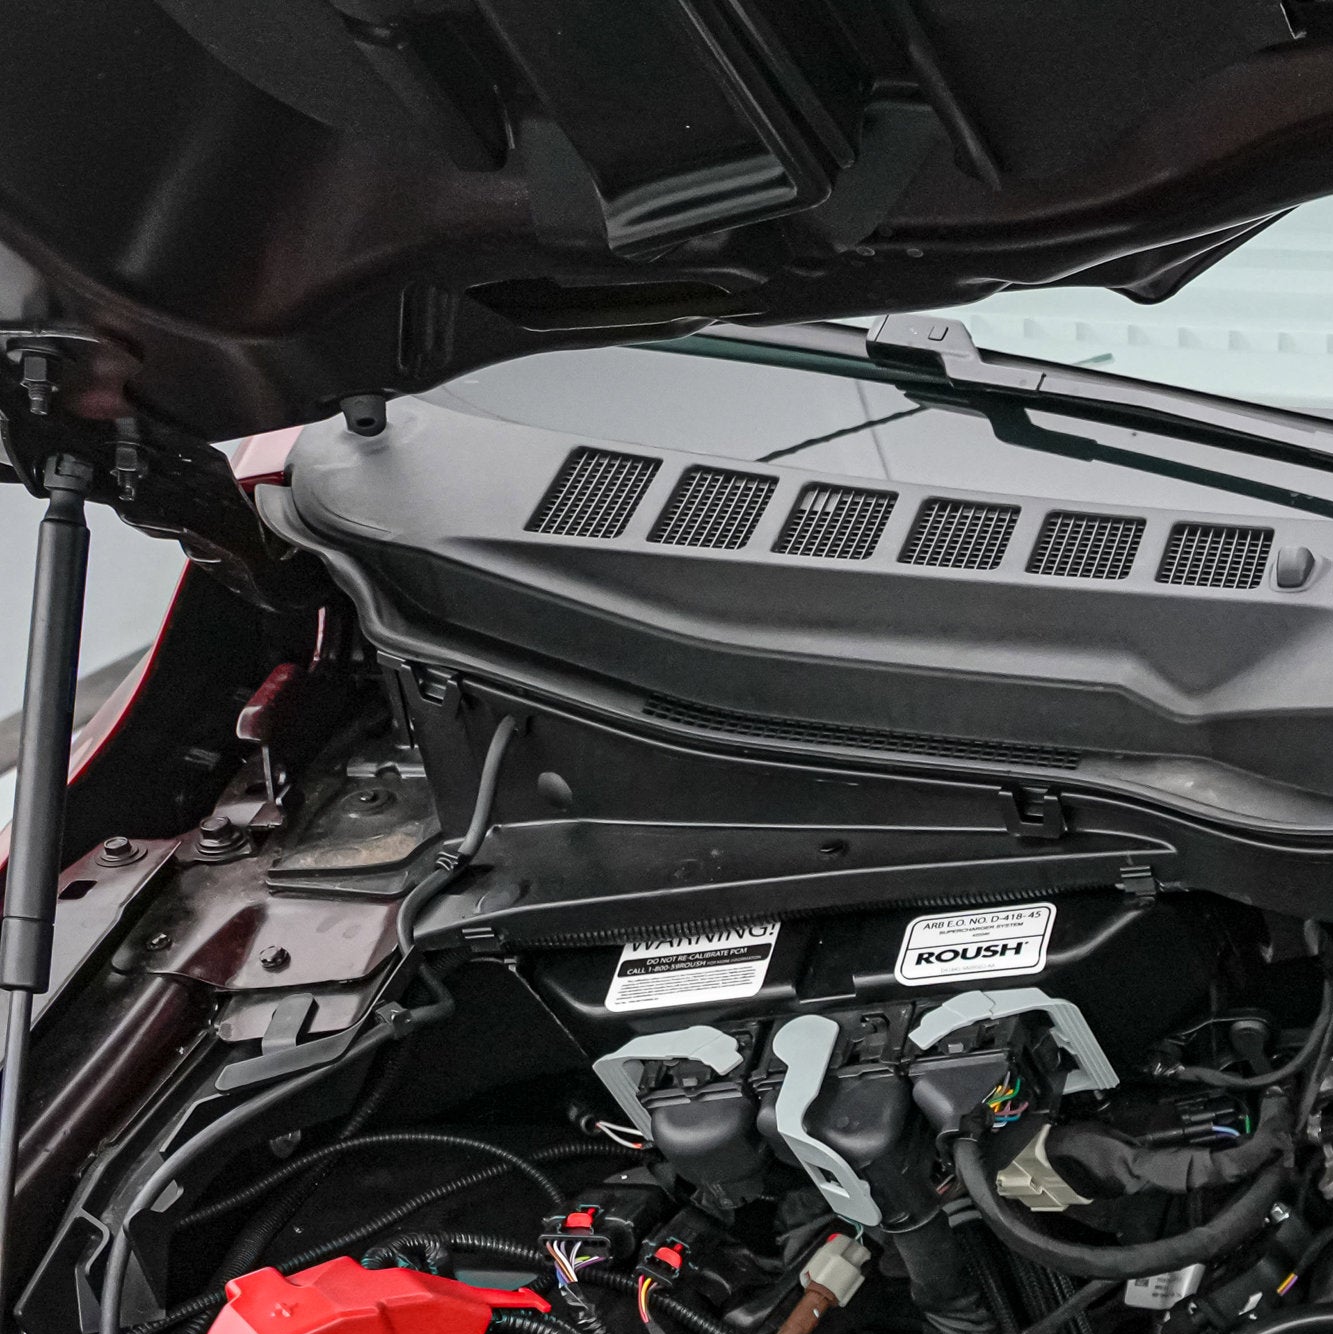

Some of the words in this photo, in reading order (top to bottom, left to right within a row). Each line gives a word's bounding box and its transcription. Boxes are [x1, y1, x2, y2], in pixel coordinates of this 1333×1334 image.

[969, 917, 987, 925] NO.
[660, 956, 677, 964] NOT
[678, 950, 729, 962] RE-CALIBRATE
[916, 942, 1024, 965] ROUSH
